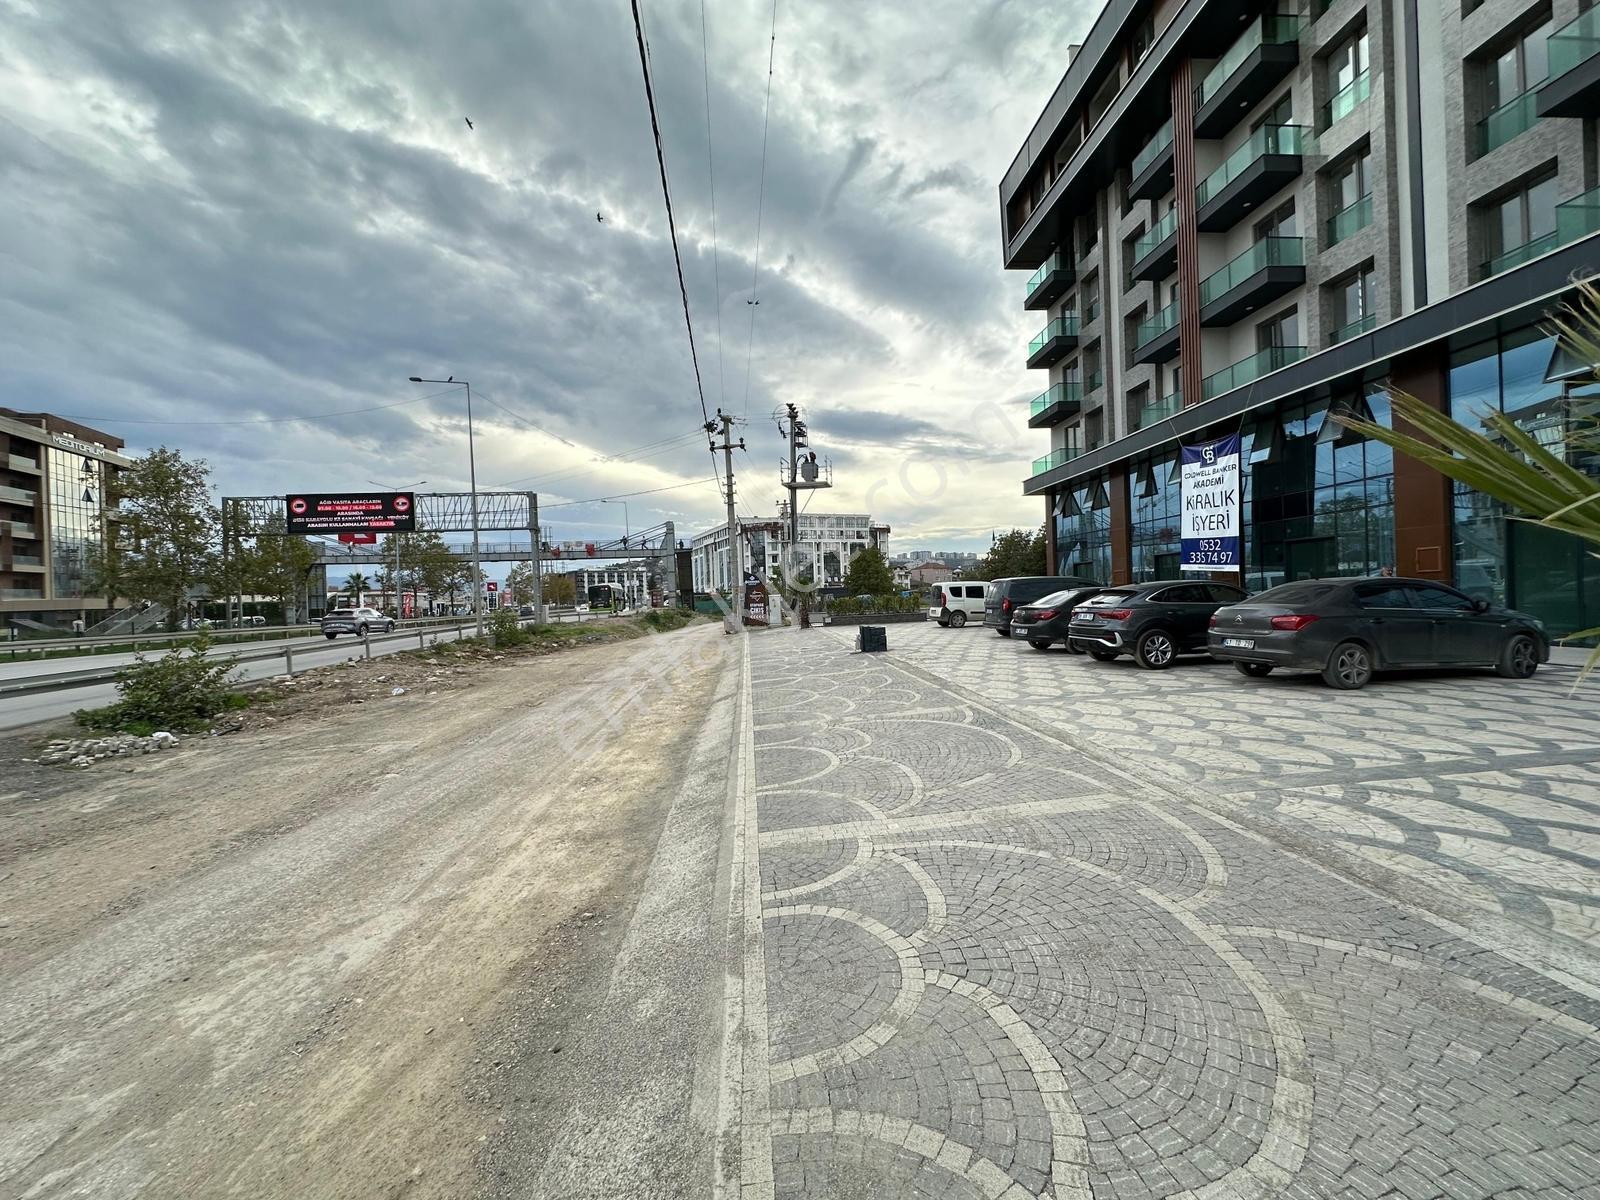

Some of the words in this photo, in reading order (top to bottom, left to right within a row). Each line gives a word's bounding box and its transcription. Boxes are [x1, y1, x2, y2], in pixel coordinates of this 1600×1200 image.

[52, 435, 105, 457] MEDITORIUM
[1184, 469, 1211, 480] COLDWELL
[1212, 463, 1237, 475] BANKER
[1193, 474, 1224, 489] AKADEMİ
[1186, 489, 1235, 511] KİRALIK
[1192, 510, 1230, 535] İŞYERİ
[1199, 539, 1221, 551] 0532
[1220, 552, 1233, 562] 97
